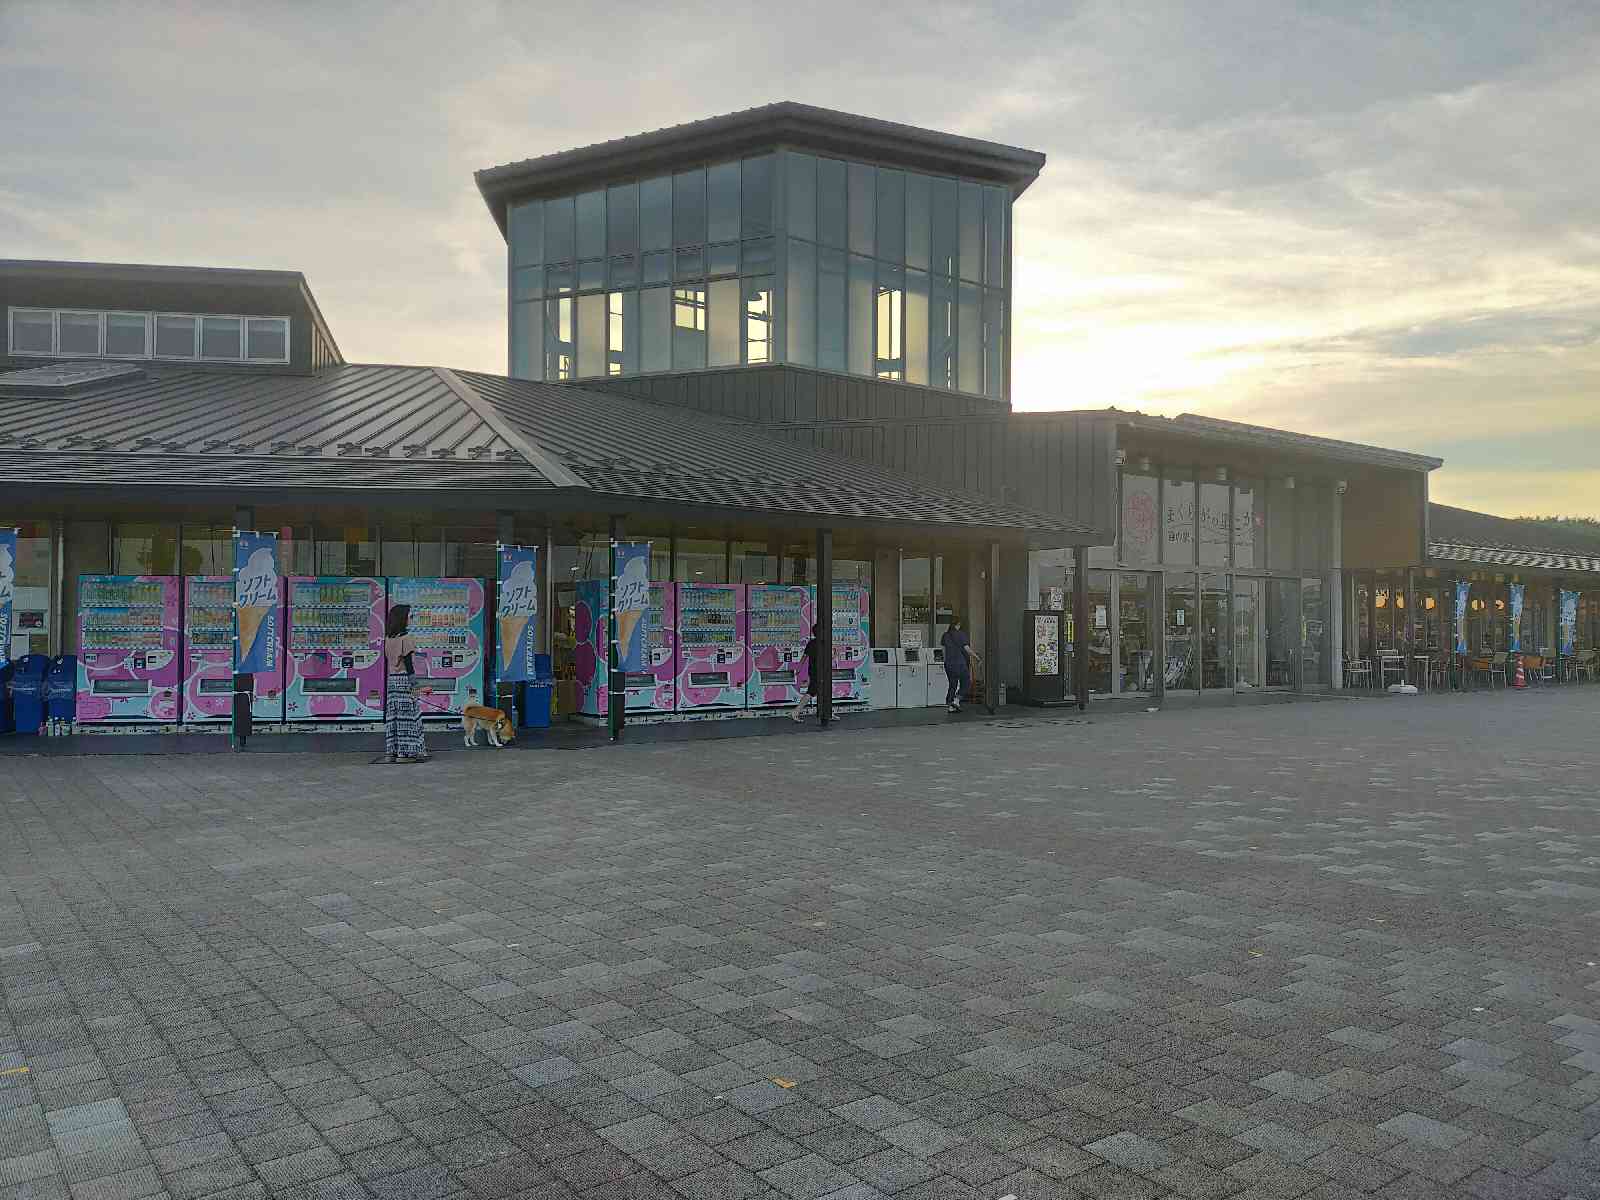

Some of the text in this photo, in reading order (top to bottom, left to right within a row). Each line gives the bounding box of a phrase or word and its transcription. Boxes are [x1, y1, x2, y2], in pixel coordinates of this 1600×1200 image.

[243, 573, 272, 592] ソフト
[621, 581, 643, 598] ソフト
[239, 589, 277, 608] クリーム
[506, 585, 532, 603] ソフト
[618, 593, 649, 613] クリーム
[502, 599, 536, 617] クリーム
